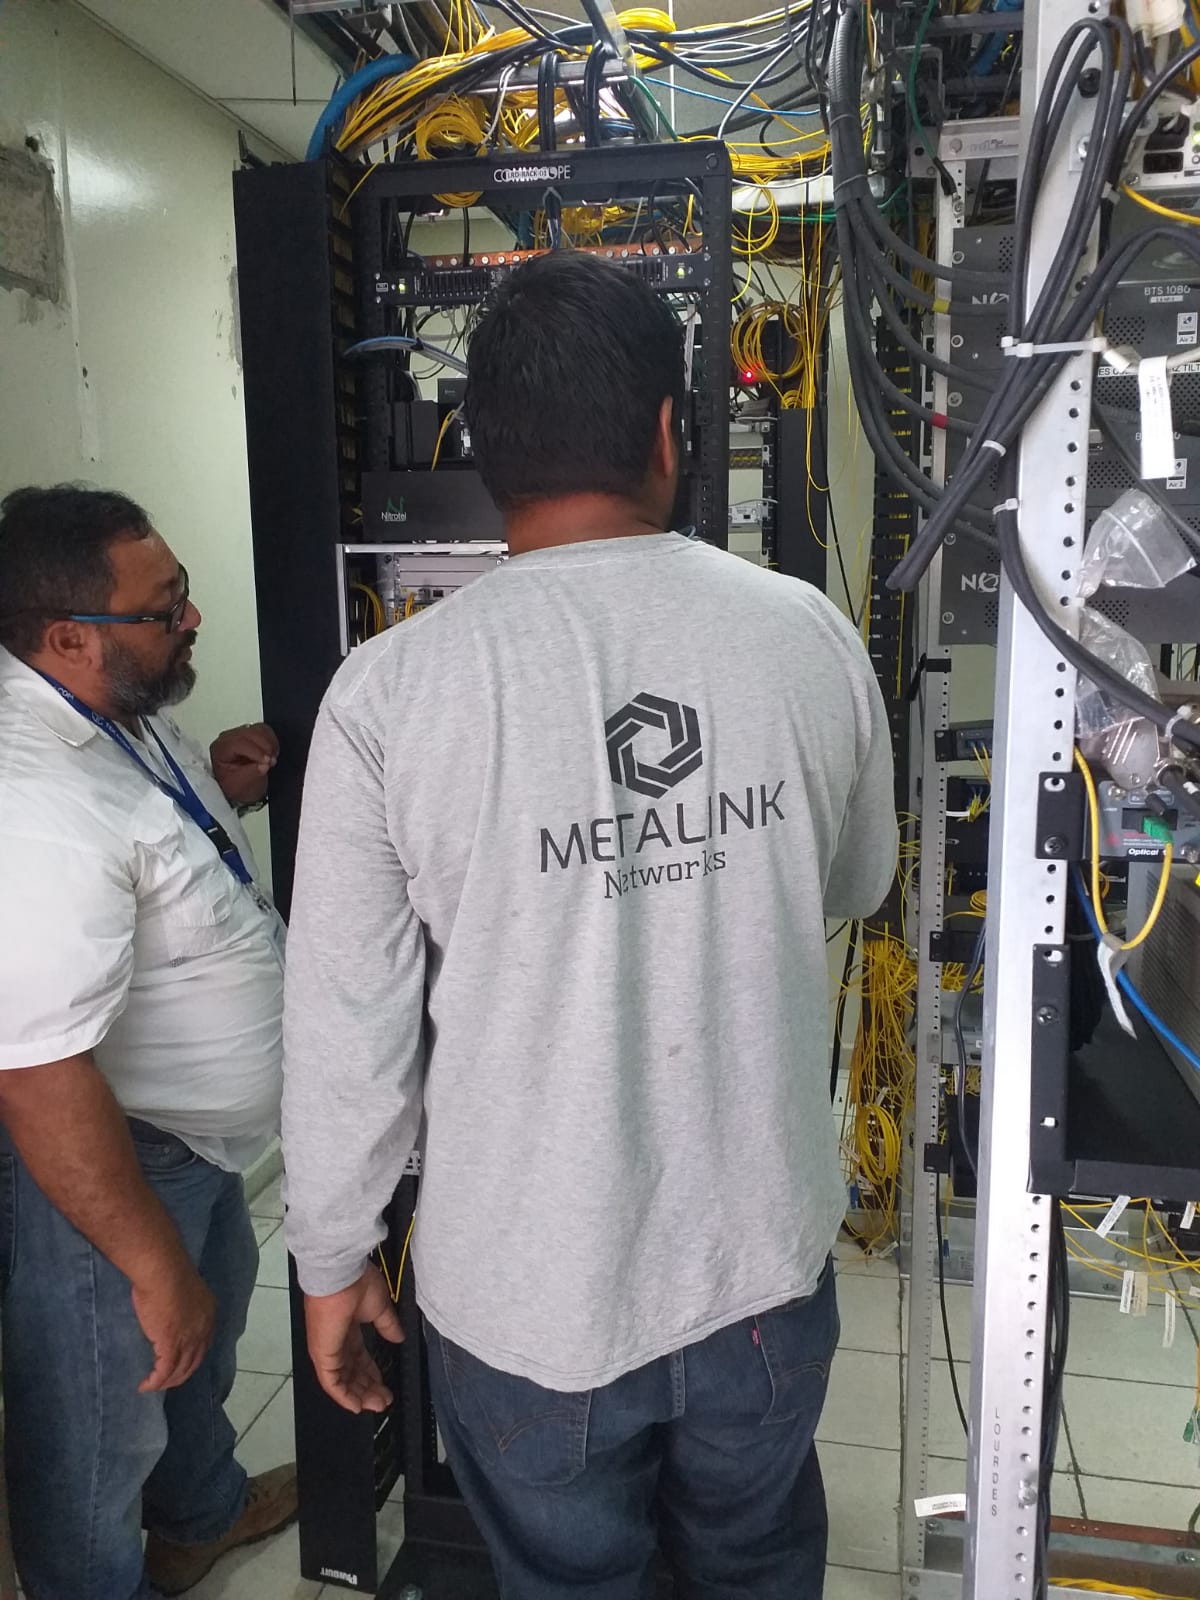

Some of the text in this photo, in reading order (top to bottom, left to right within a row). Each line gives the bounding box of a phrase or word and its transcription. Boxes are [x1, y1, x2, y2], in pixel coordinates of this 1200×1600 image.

[1144, 286, 1163, 296] BTS
[540, 780, 785, 873] METALINK
[604, 850, 726, 899] Networks
[991, 1407, 1001, 1517] LOURDES
